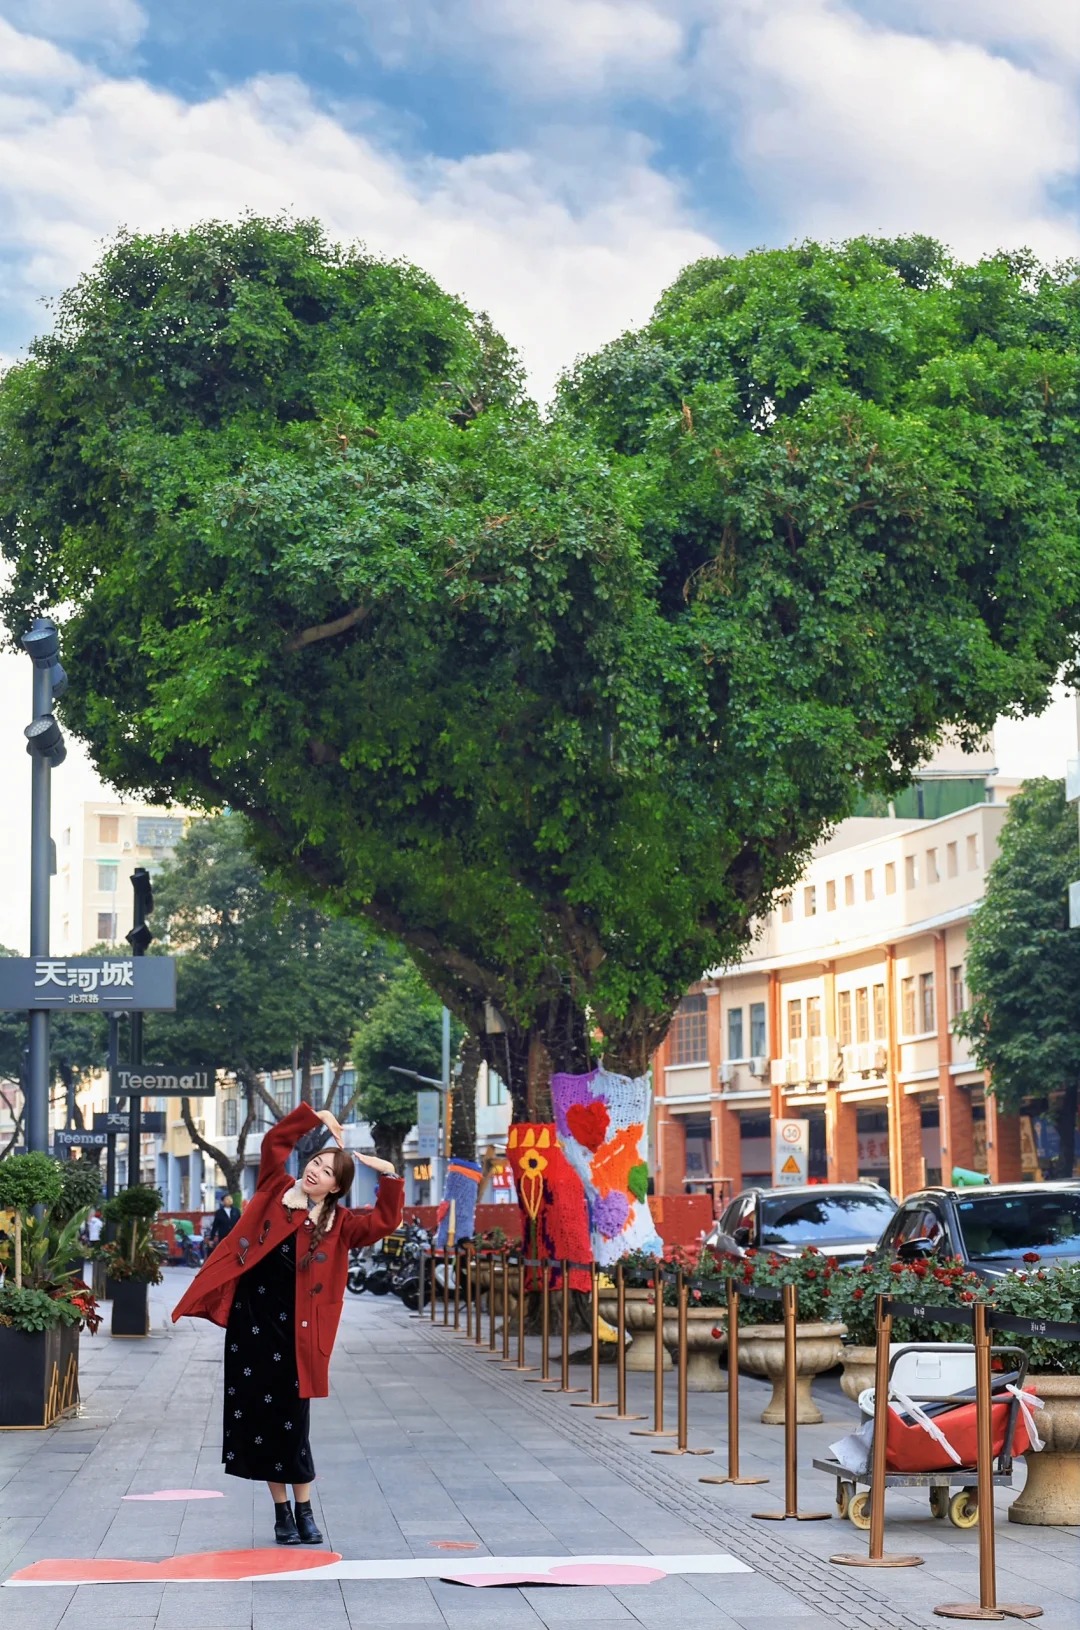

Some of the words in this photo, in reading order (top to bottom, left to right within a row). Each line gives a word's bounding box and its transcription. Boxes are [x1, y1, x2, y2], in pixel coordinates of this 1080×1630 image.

[35, 961, 134, 992] 天河城
[68, 993, 100, 1004] 北京路
[118, 1072, 209, 1089] Teemall
[57, 1132, 108, 1144] Teemal
